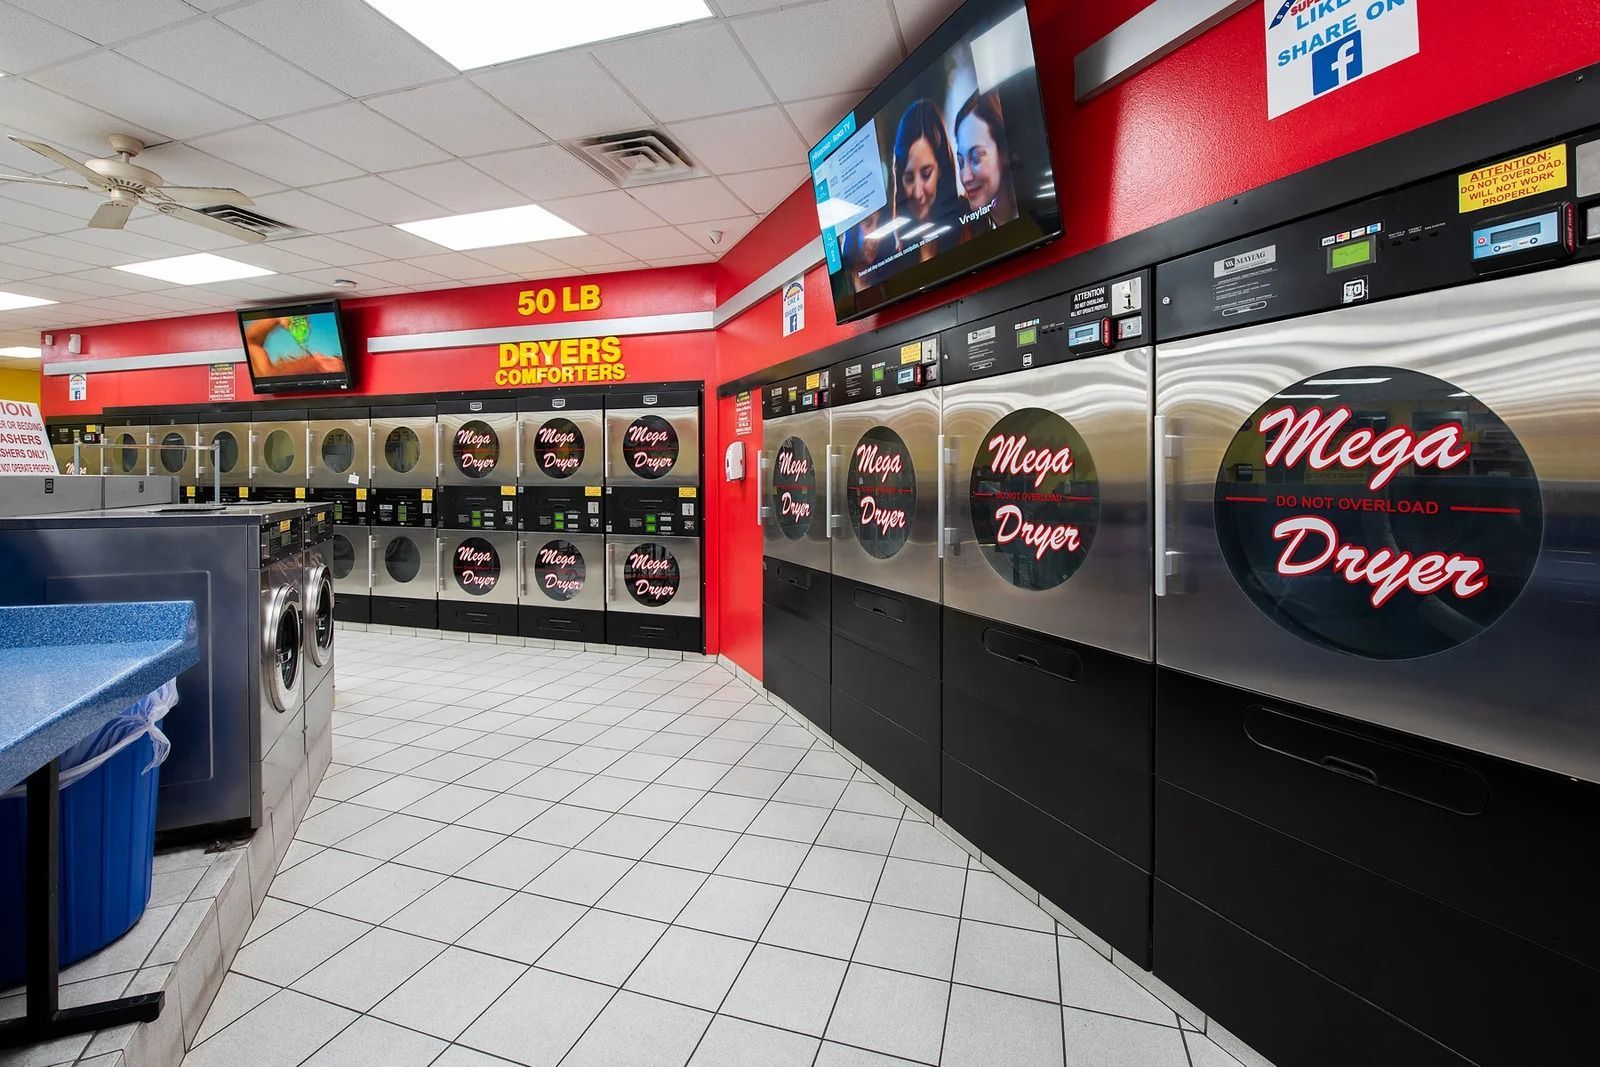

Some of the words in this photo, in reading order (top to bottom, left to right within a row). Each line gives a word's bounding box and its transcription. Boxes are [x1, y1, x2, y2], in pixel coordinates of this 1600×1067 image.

[1278, 13, 1358, 67] SHARE
[1366, 0, 1405, 21] ON
[1460, 184, 1475, 194] DO
[1477, 177, 1499, 189] NOT
[1500, 158, 1565, 182] OVERLOAD.
[1469, 151, 1551, 183] ATTENTION:
[1469, 188, 1494, 201] WILL
[1495, 181, 1518, 193] NOT
[1520, 170, 1555, 187] WORK
[1482, 184, 1541, 207] PROPERLY.
[958, 203, 993, 226] Vraylar
[1236, 251, 1266, 265] MAYTAG
[517, 288, 556, 317] 50
[561, 283, 602, 313] LB
[1073, 286, 1105, 303] ATTENTION
[499, 335, 623, 369] DRYERS
[494, 363, 626, 386] COMFORTERS
[17, 421, 43, 432] BEDDING
[538, 427, 575, 448] Mega
[628, 425, 668, 447] Mega
[457, 427, 491, 450] Mega
[1258, 404, 1471, 491] Mega
[27, 449, 49, 461] ONLY)
[461, 453, 495, 472] Dryer
[543, 452, 580, 471] Dryer
[633, 451, 673, 471] Dryer
[856, 443, 902, 484] Mega
[988, 433, 1074, 488] Mega
[11, 463, 32, 473] OPERATE
[32, 463, 55, 473] PROPERLY
[778, 451, 809, 483] Mega
[780, 491, 812, 523] Dryer
[860, 495, 906, 536] Dryer
[1276, 495, 1297, 508] DO
[1301, 496, 1334, 510] NOT
[1338, 498, 1439, 514] OVERLOAD
[995, 503, 1080, 561] Dryer
[457, 546, 492, 565] Mega
[539, 548, 576, 568] Mega
[629, 553, 669, 574] Mega
[1272, 514, 1488, 608] Dryer
[462, 570, 496, 589] Dryer
[544, 573, 581, 593] Dryer
[635, 579, 674, 600] Dryer
